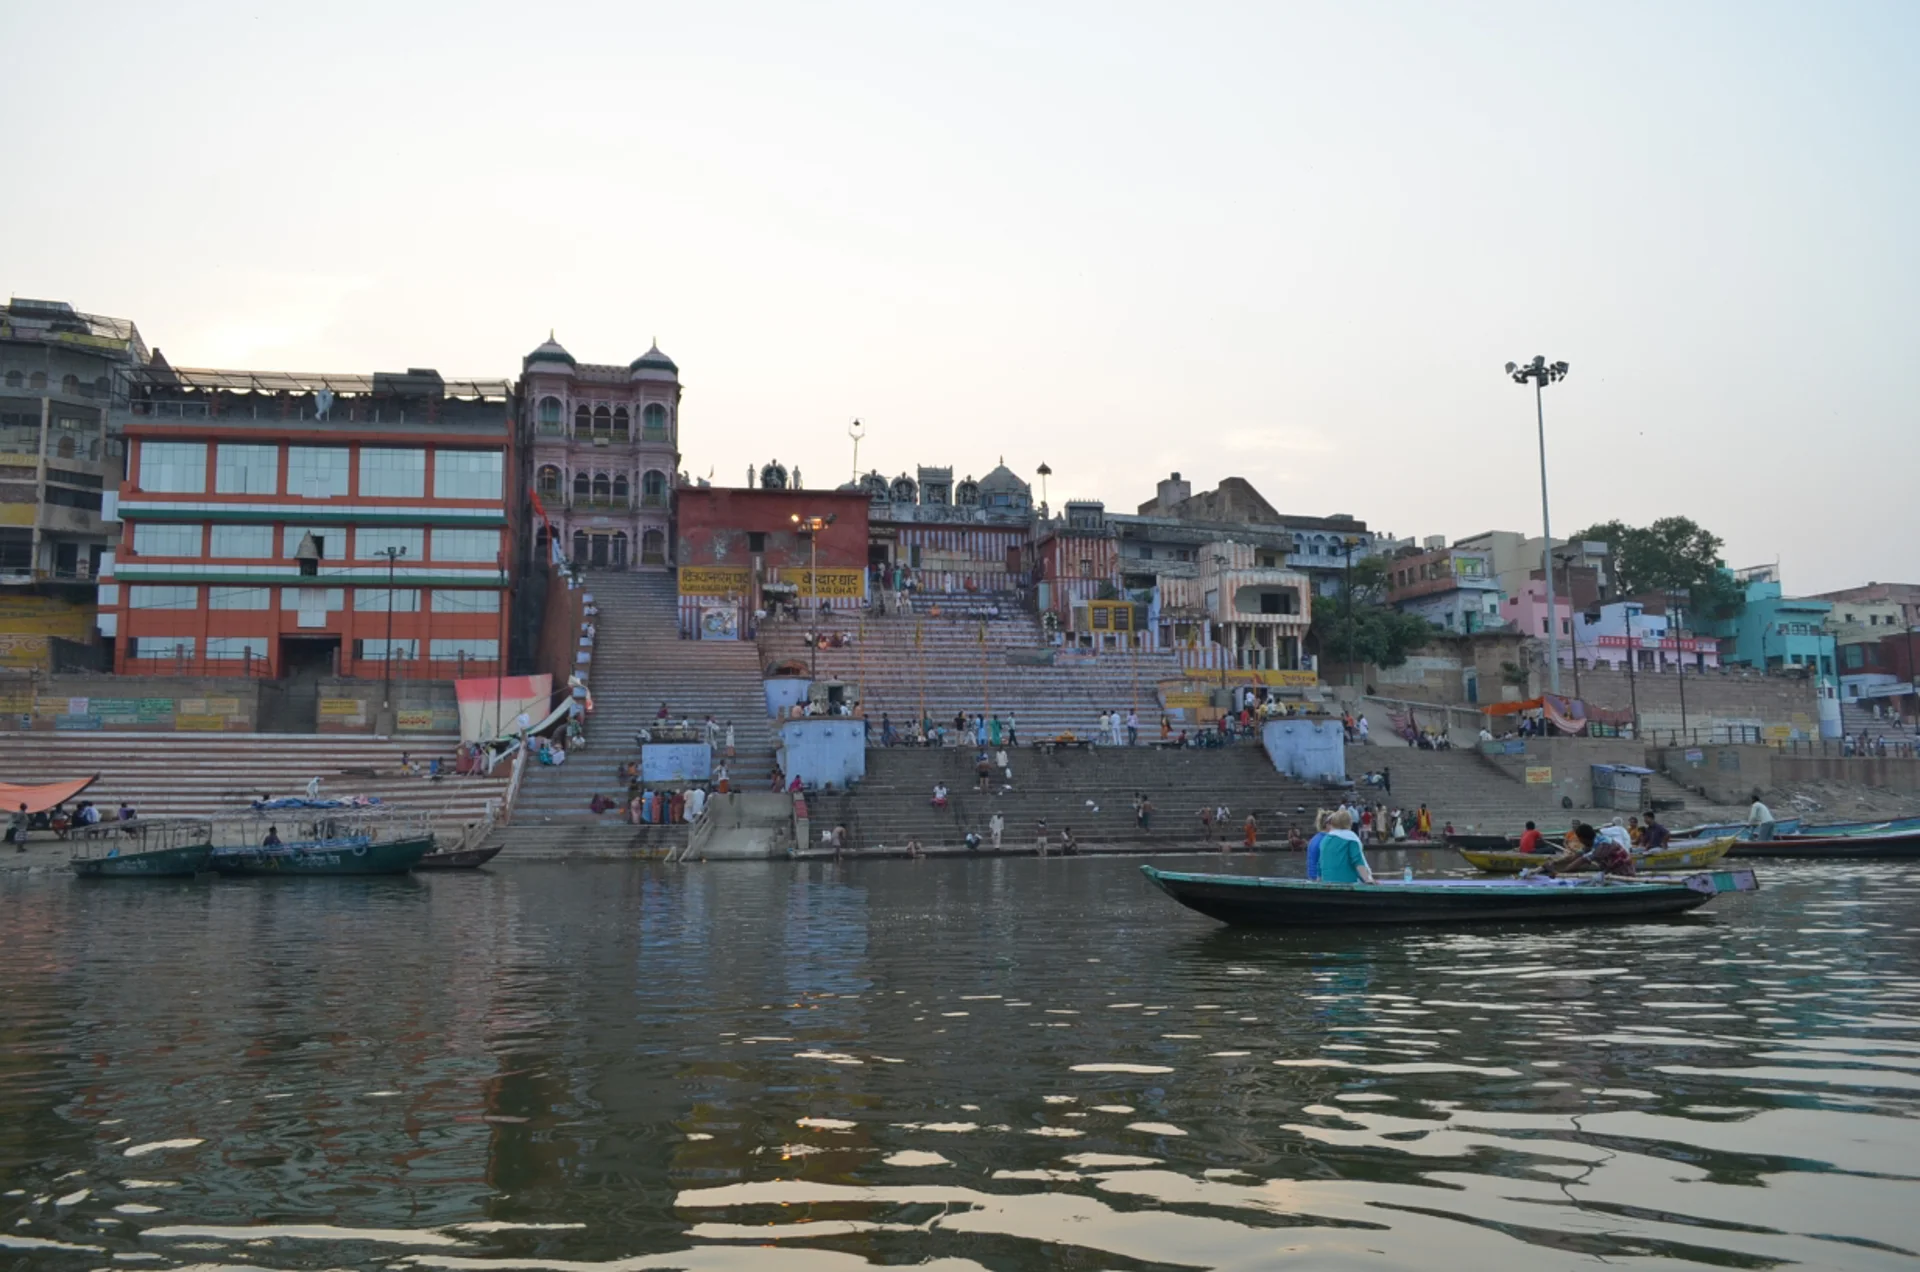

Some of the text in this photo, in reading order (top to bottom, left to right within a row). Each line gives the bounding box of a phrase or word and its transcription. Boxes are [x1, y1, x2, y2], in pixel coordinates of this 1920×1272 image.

[802, 571, 858, 586] केदार घाट
[802, 586, 858, 595] KEDAR GHAT
